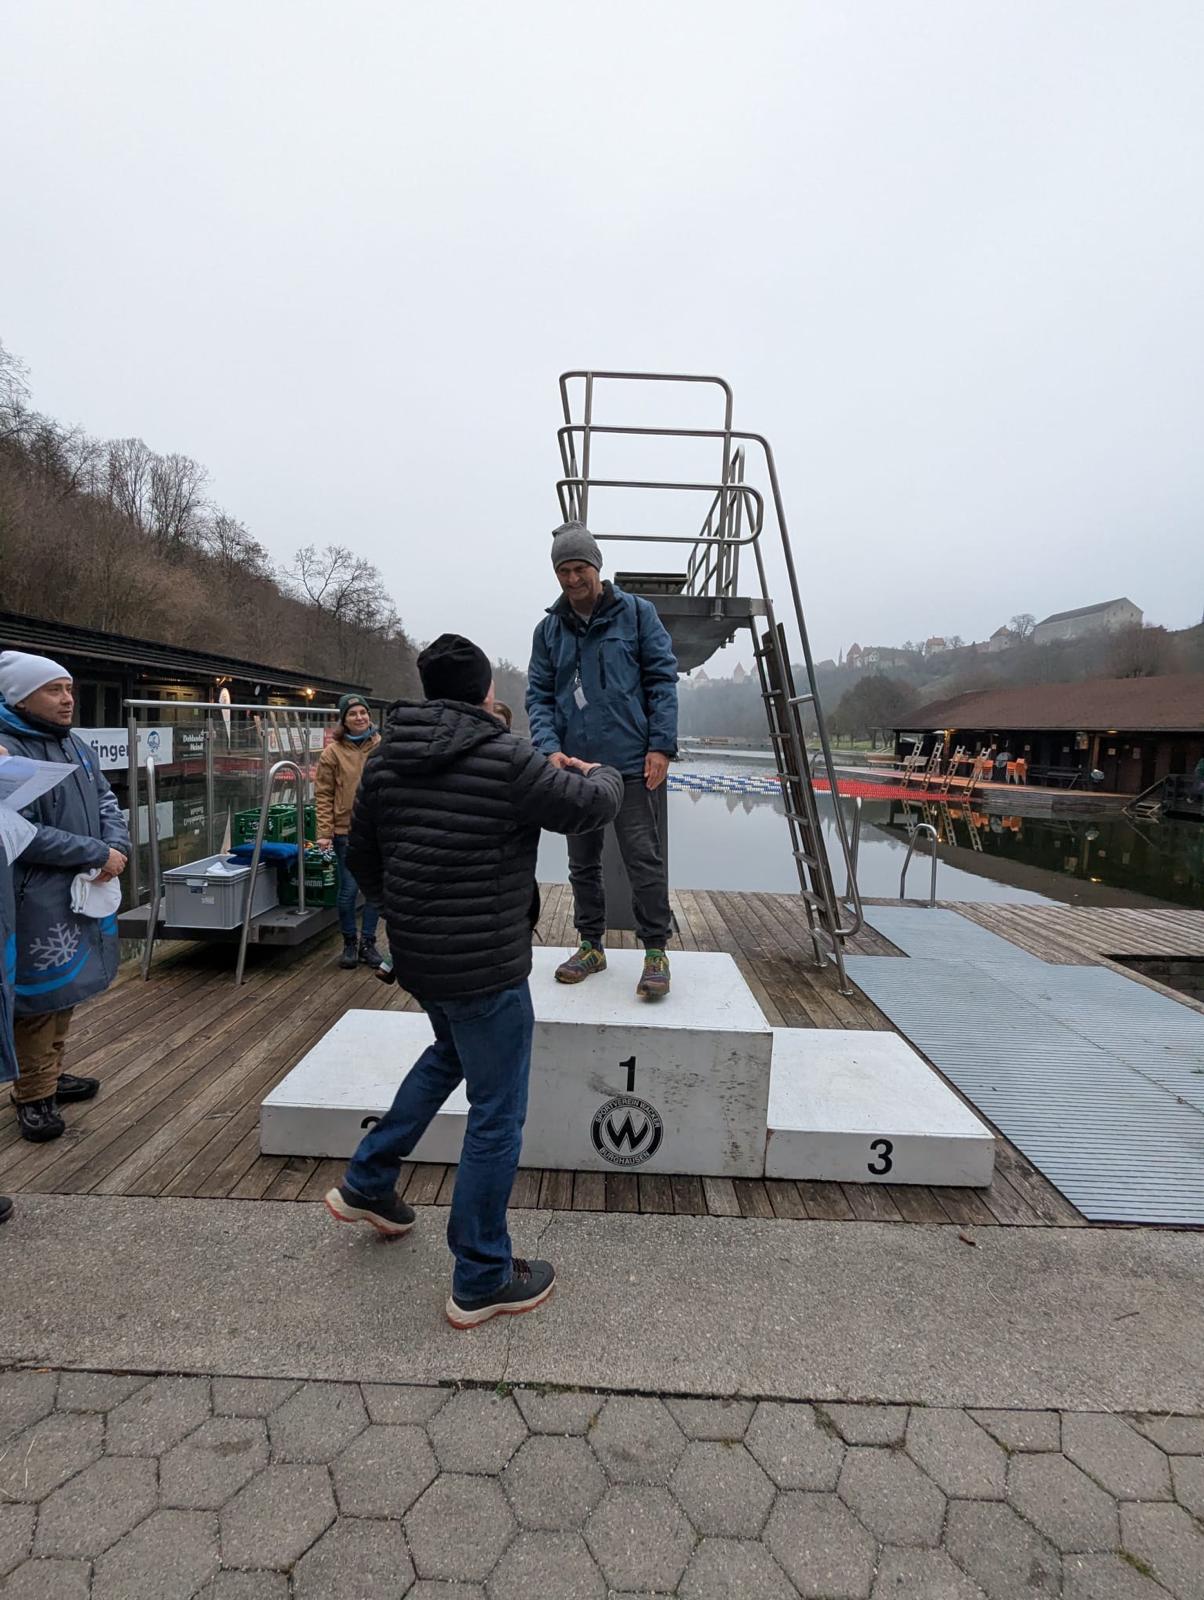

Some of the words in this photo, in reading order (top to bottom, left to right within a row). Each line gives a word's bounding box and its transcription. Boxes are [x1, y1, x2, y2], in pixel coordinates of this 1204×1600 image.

[619, 1055, 636, 1092] 1
[595, 1098, 639, 1123] SPORTVEREIN
[640, 1102, 661, 1128] WACKER
[605, 1110, 651, 1153] W
[599, 1147, 650, 1165] BURGHAUSEN
[867, 1138, 893, 1175] 3
